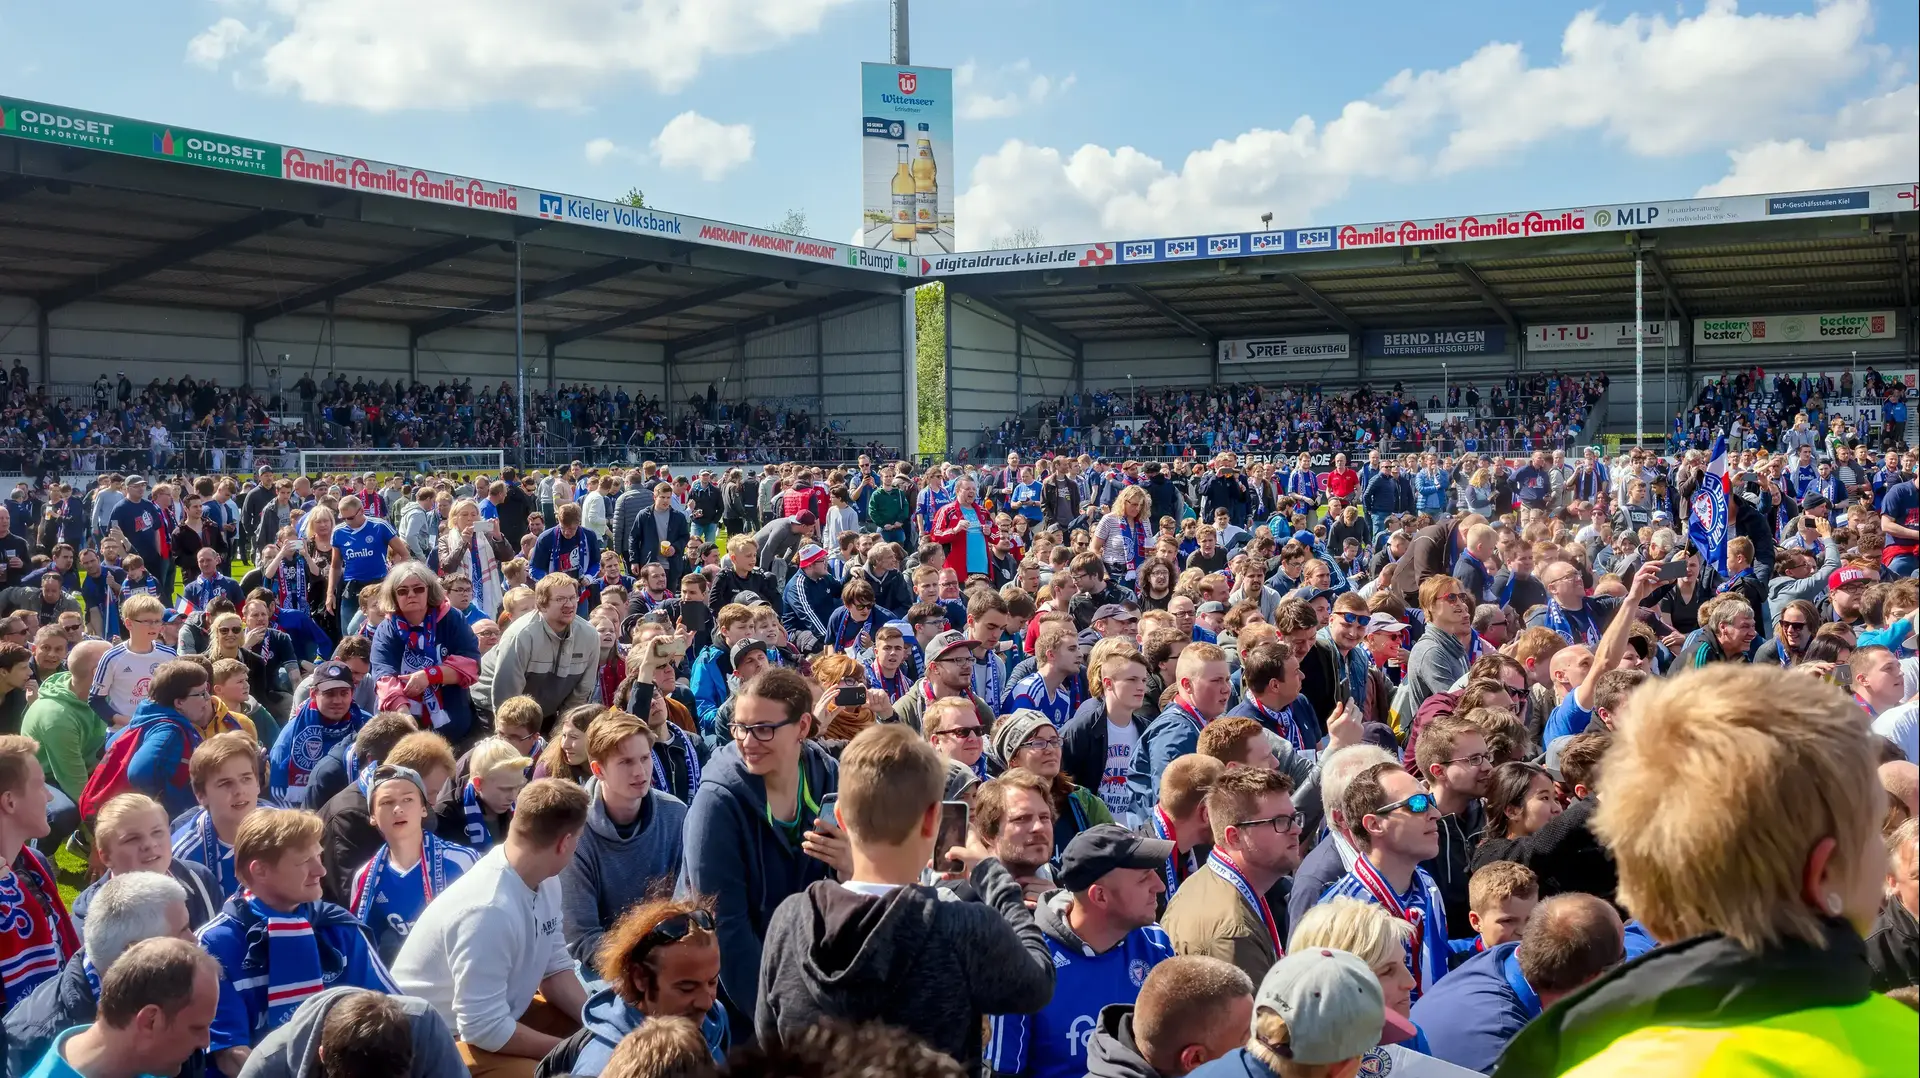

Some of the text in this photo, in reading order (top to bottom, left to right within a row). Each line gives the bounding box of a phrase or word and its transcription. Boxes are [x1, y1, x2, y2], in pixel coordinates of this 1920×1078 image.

[881, 93, 935, 106] Wittenseer
[20, 110, 114, 136] ODDSET
[21, 125, 115, 146] DIE SPORTWETTE
[187, 138, 266, 161] ODDSET
[187, 151, 266, 170] DIE SPORTWETTE
[283, 149, 517, 211] famila famila famila famila
[568, 200, 681, 235] Kieler Volksbank
[1617, 207, 1660, 226] MLP
[1299, 231, 1329, 245] RSH
[1338, 211, 1585, 249] famila famila famila famila
[699, 225, 837, 260] MARKANT MARKANT MARKANT
[1167, 241, 1195, 254] RSH
[1210, 238, 1238, 251] RSH
[1253, 235, 1282, 248] RSH
[1125, 244, 1153, 257] RSH
[859, 249, 894, 270] Rumpf
[935, 249, 1076, 272] digitaldruck-kiel.de
[1383, 331, 1485, 346] BERND HAGEN
[1703, 330, 1742, 340] bester
[1820, 325, 1860, 336] bester
[1246, 340, 1288, 359] SPREE
[1383, 344, 1485, 355] UNTERNEHMENSGRUPPE
[345, 548, 374, 560] famila
[1107, 794, 1121, 805] WIR
